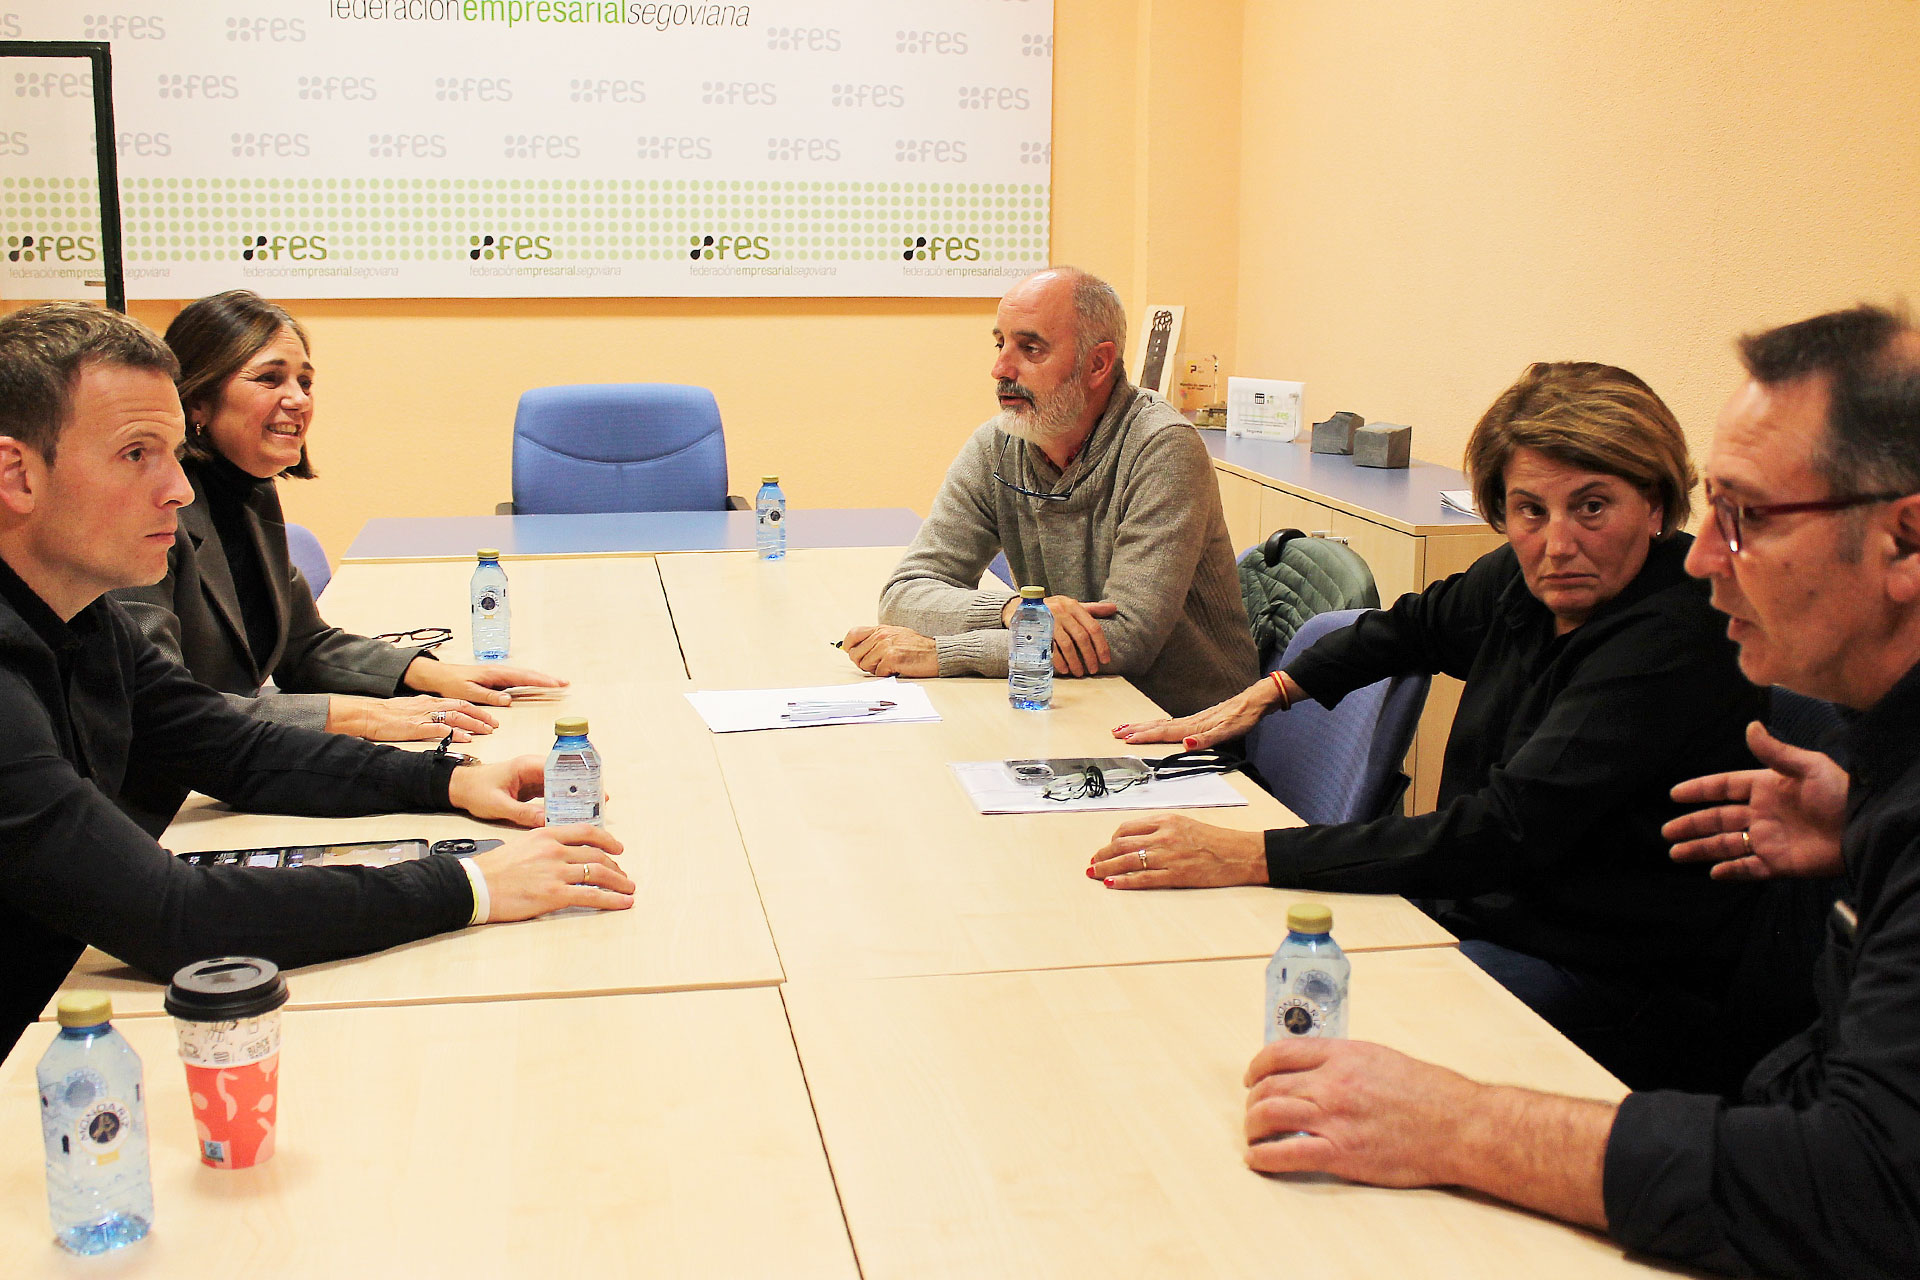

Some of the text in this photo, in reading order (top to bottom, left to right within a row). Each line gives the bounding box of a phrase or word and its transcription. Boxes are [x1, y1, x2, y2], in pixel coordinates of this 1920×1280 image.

[109, 15, 166, 40] fes
[248, 17, 306, 42] fes
[789, 28, 841, 51] fes
[920, 31, 968, 55] fes
[182, 75, 239, 99] fes
[323, 77, 377, 101] fes
[460, 78, 512, 102] fes
[593, 80, 646, 103] fes
[724, 82, 777, 105] fes
[854, 85, 905, 108] fes
[980, 87, 1030, 110] fes
[117, 132, 171, 157] fes
[255, 133, 310, 157] fes
[394, 135, 447, 158] fes
[527, 135, 581, 159] fes
[660, 137, 712, 160] fes
[790, 138, 841, 162] fes
[918, 140, 967, 163] fes
[35, 236, 96, 262] fes
[269, 236, 327, 261] fes
[495, 236, 553, 260] fes
[715, 236, 770, 260] fes
[928, 237, 980, 261] fes
